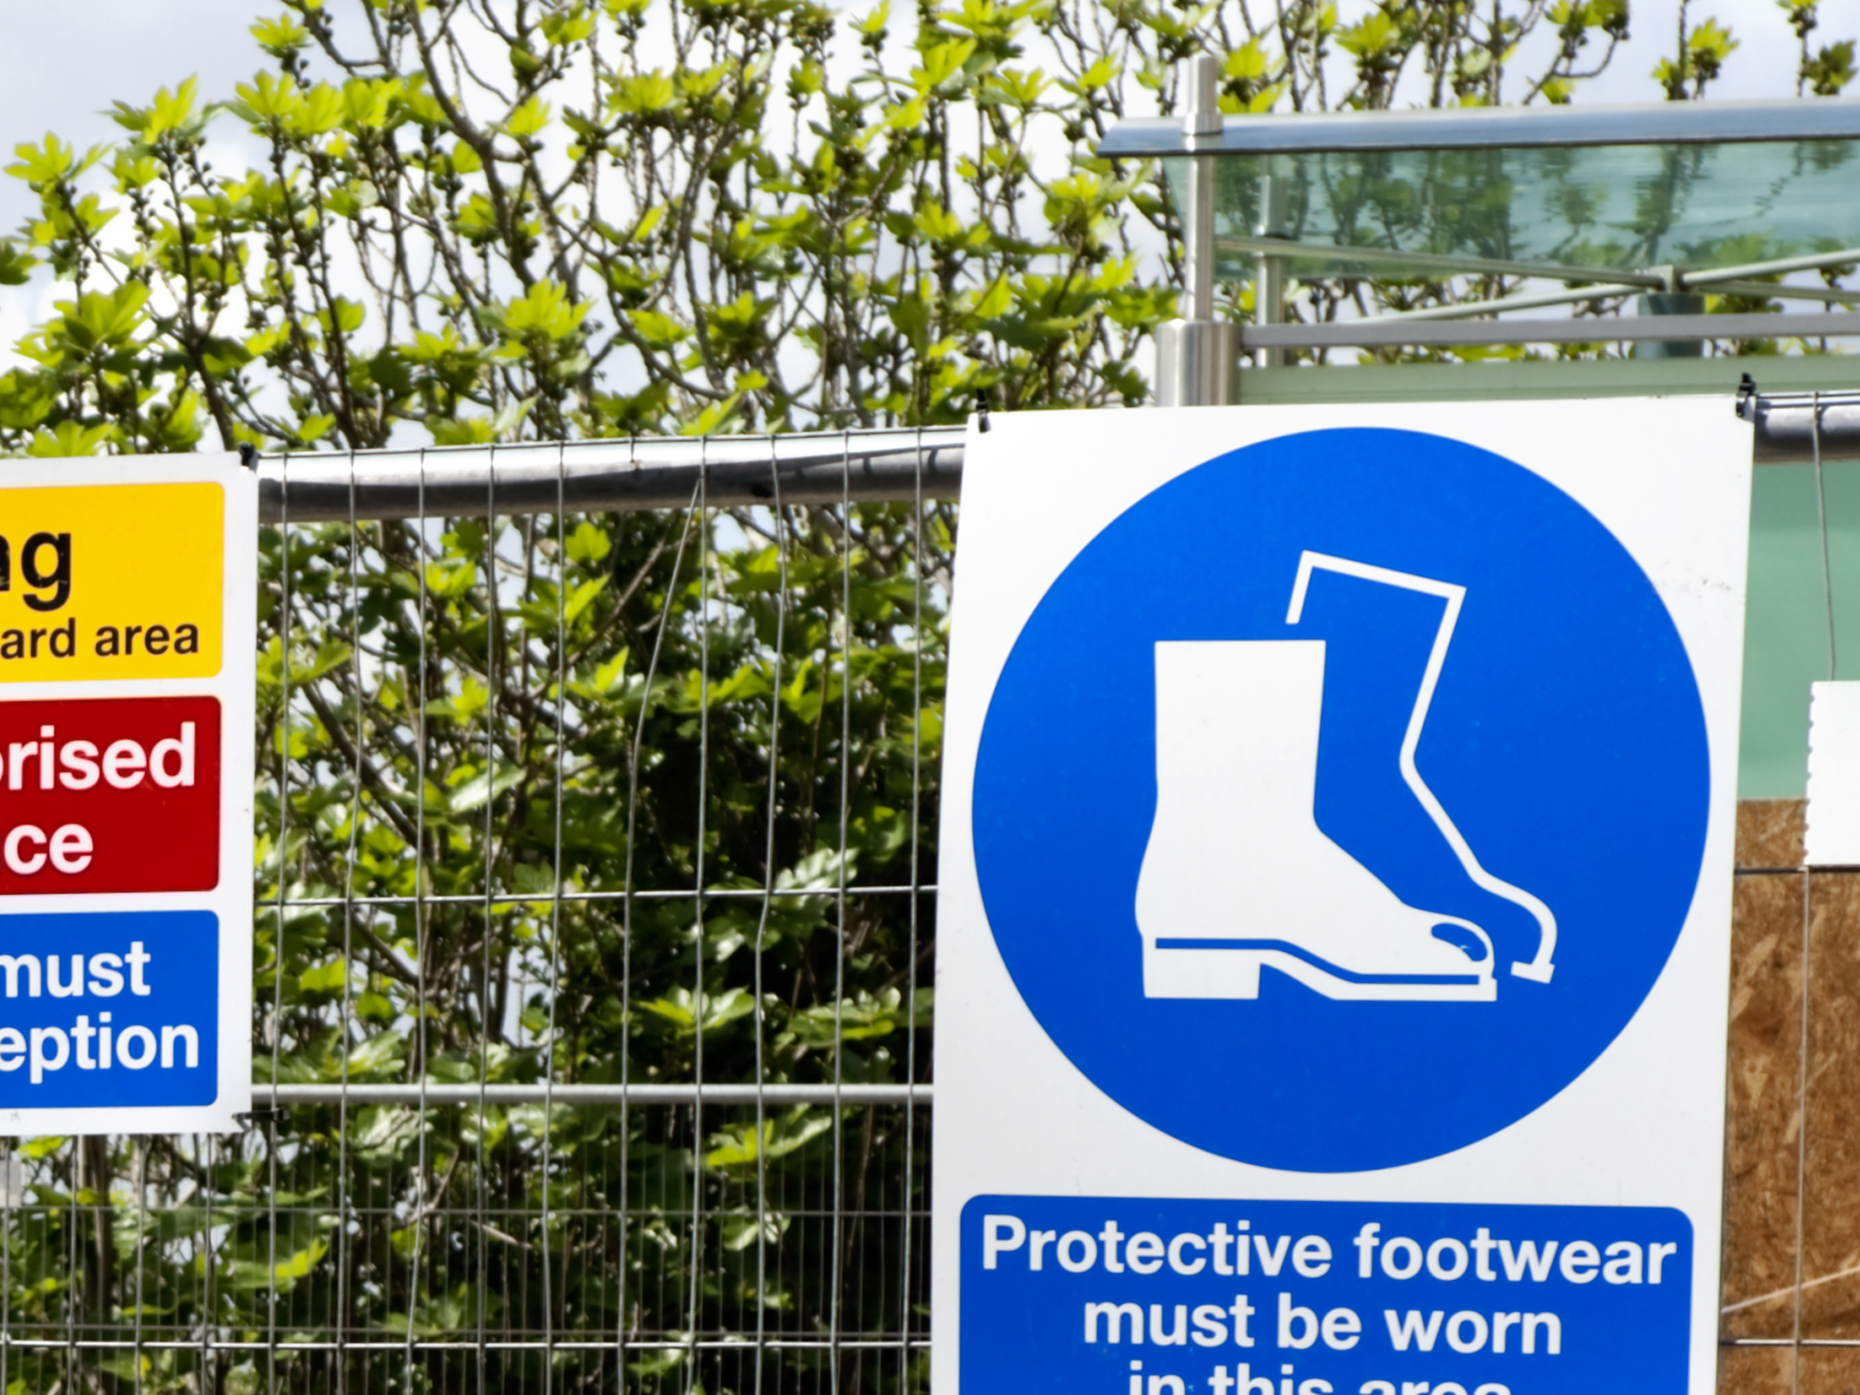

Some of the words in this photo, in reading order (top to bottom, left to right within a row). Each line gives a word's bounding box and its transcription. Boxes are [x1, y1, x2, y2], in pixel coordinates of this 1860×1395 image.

[95, 624, 198, 657] area
[983, 1214, 1333, 1278] Protective
[1353, 1222, 1677, 1285] footwear
[1084, 1294, 1256, 1348] must
[1277, 1292, 1362, 1351] be
[1383, 1309, 1562, 1355] worn
